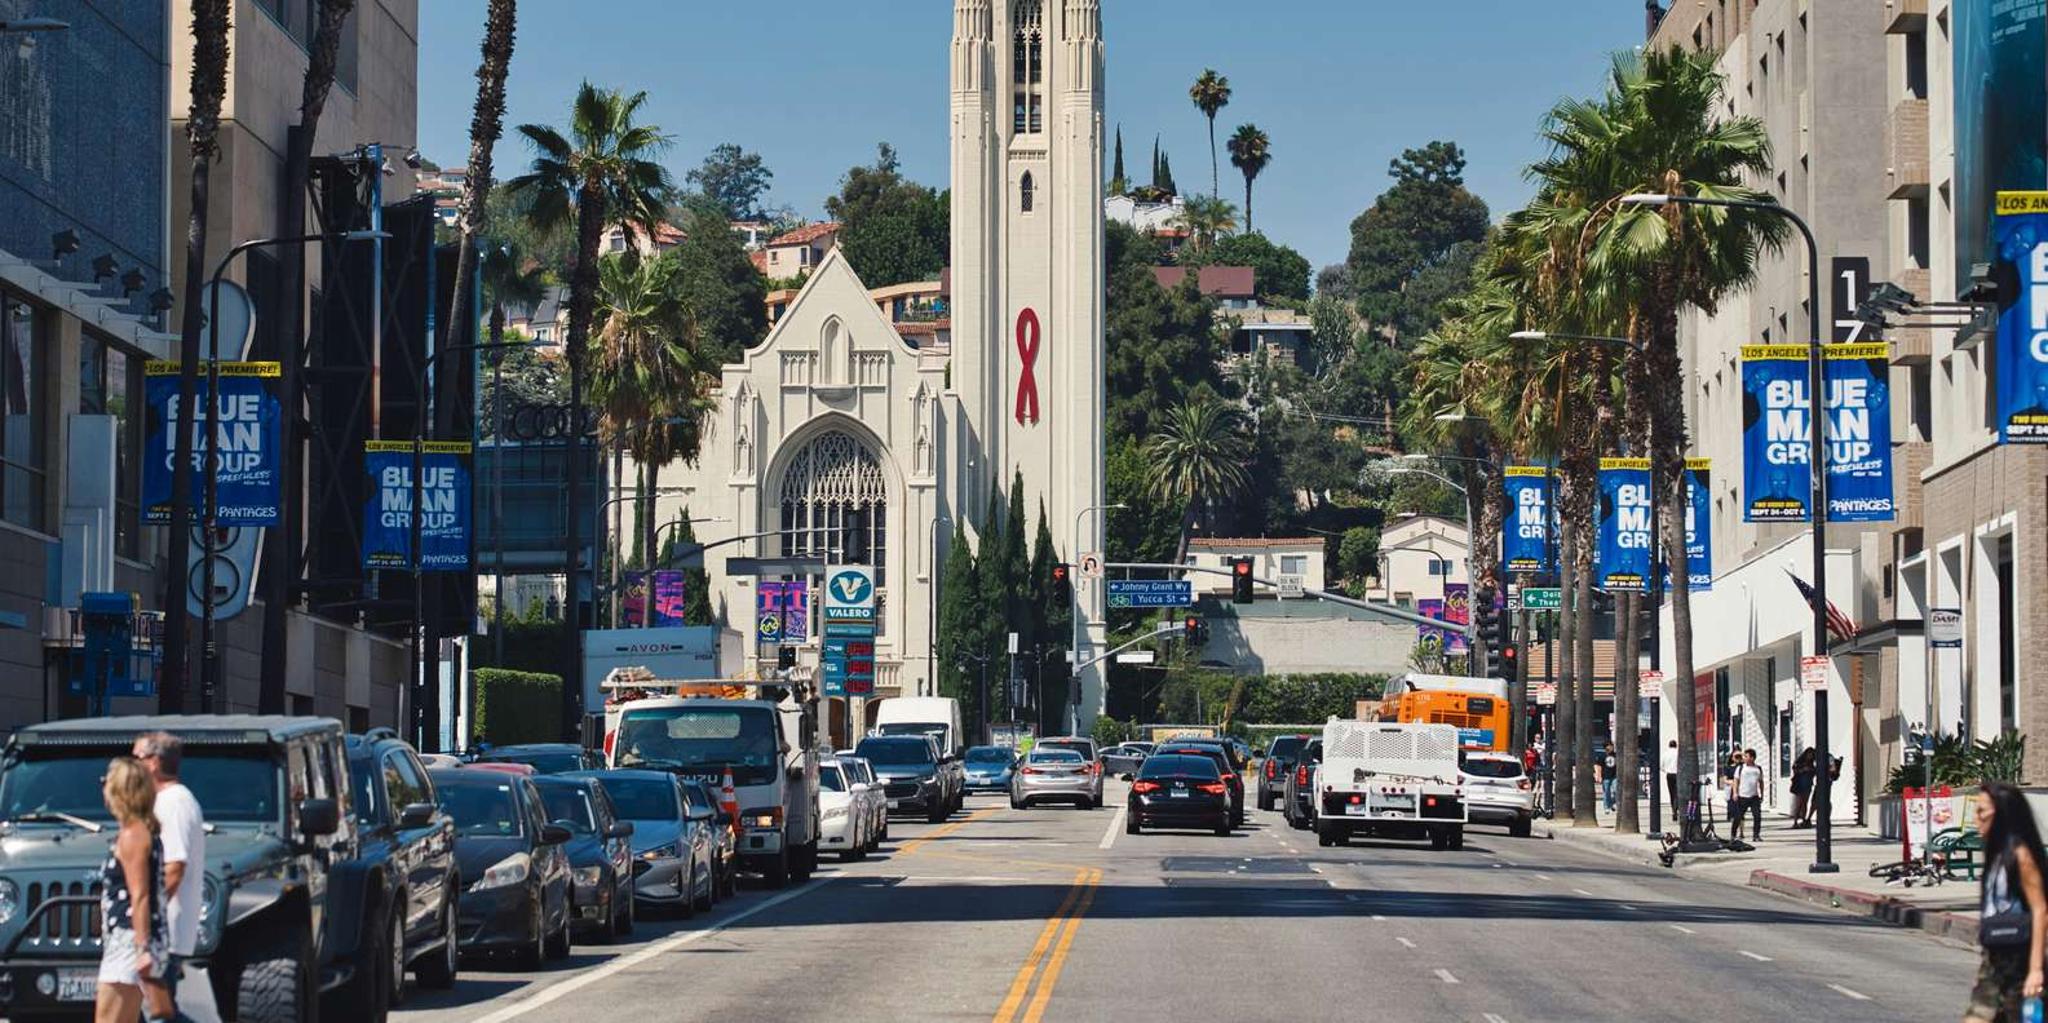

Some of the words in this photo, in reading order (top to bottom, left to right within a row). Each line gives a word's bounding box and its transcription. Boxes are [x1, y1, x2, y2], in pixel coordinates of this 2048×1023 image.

[2003, 197, 2027, 209] LOS
[1746, 350, 1764, 358] LOS
[1767, 349, 1809, 358] ANGELES
[1767, 379, 1868, 408] BLUE
[1767, 408, 1870, 442] MAN
[1766, 441, 1872, 465] GROUP
[382, 467, 456, 488] BLUE
[381, 488, 456, 512] MAN
[1829, 498, 1891, 512] PANTAGES
[219, 506, 277, 518] PANTAGES
[1120, 583, 1150, 592] Johnny
[1152, 583, 1173, 591] Grant
[1175, 583, 1188, 591] Wy
[1138, 595, 1163, 603] Yucca
[1166, 594, 1177, 603] St
[829, 609, 871, 617] VALERO
[630, 644, 670, 652] AVON
